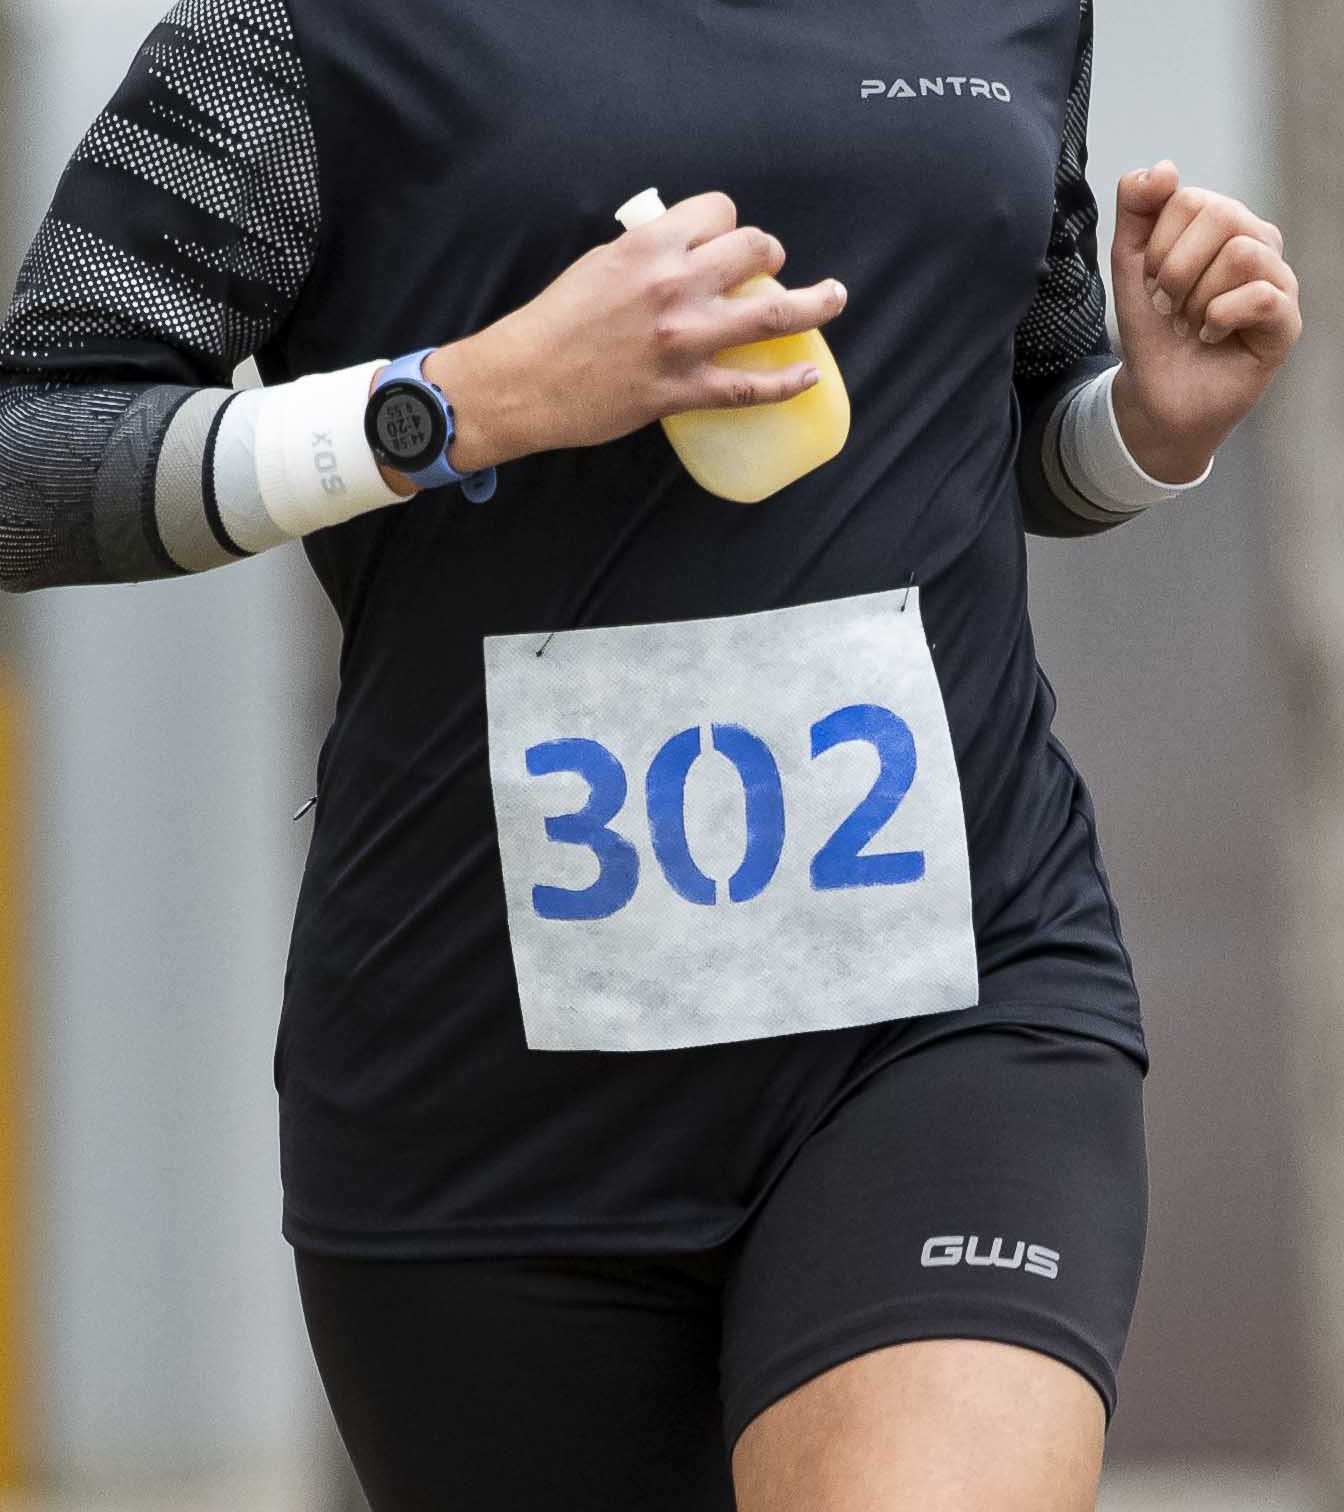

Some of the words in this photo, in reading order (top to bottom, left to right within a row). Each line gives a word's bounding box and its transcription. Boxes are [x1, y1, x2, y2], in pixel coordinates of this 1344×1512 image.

[861, 76, 1011, 103] PANTRO
[312, 431, 346, 496] SOX
[524, 703, 926, 921] 302
[921, 1236, 1060, 1280] GWS
